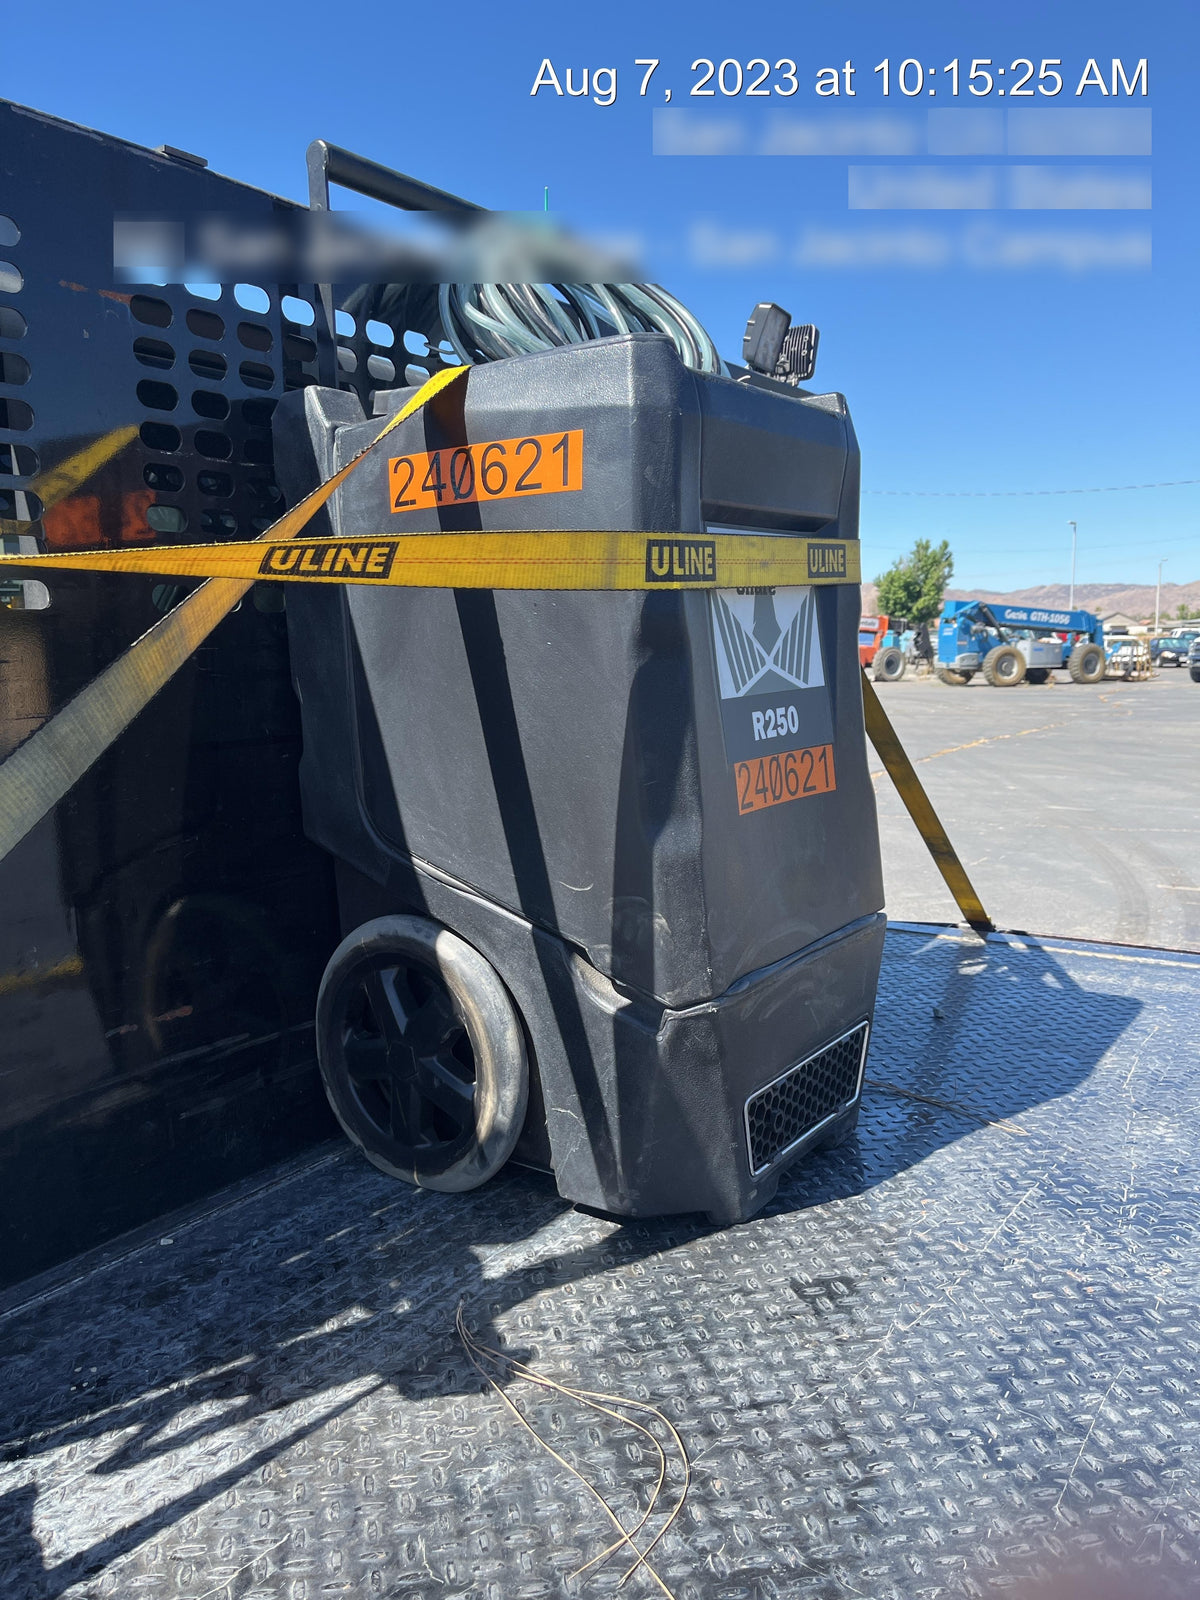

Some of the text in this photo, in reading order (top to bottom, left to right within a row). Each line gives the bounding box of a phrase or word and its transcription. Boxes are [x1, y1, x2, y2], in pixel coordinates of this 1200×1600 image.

[392, 432, 570, 509] 240621
[267, 543, 393, 575] ULINE
[650, 545, 714, 577] ULINE
[809, 547, 845, 574] ULINE
[1030, 611, 1070, 625] GTH-1056
[751, 704, 799, 741] R250
[737, 746, 831, 810] 240621
